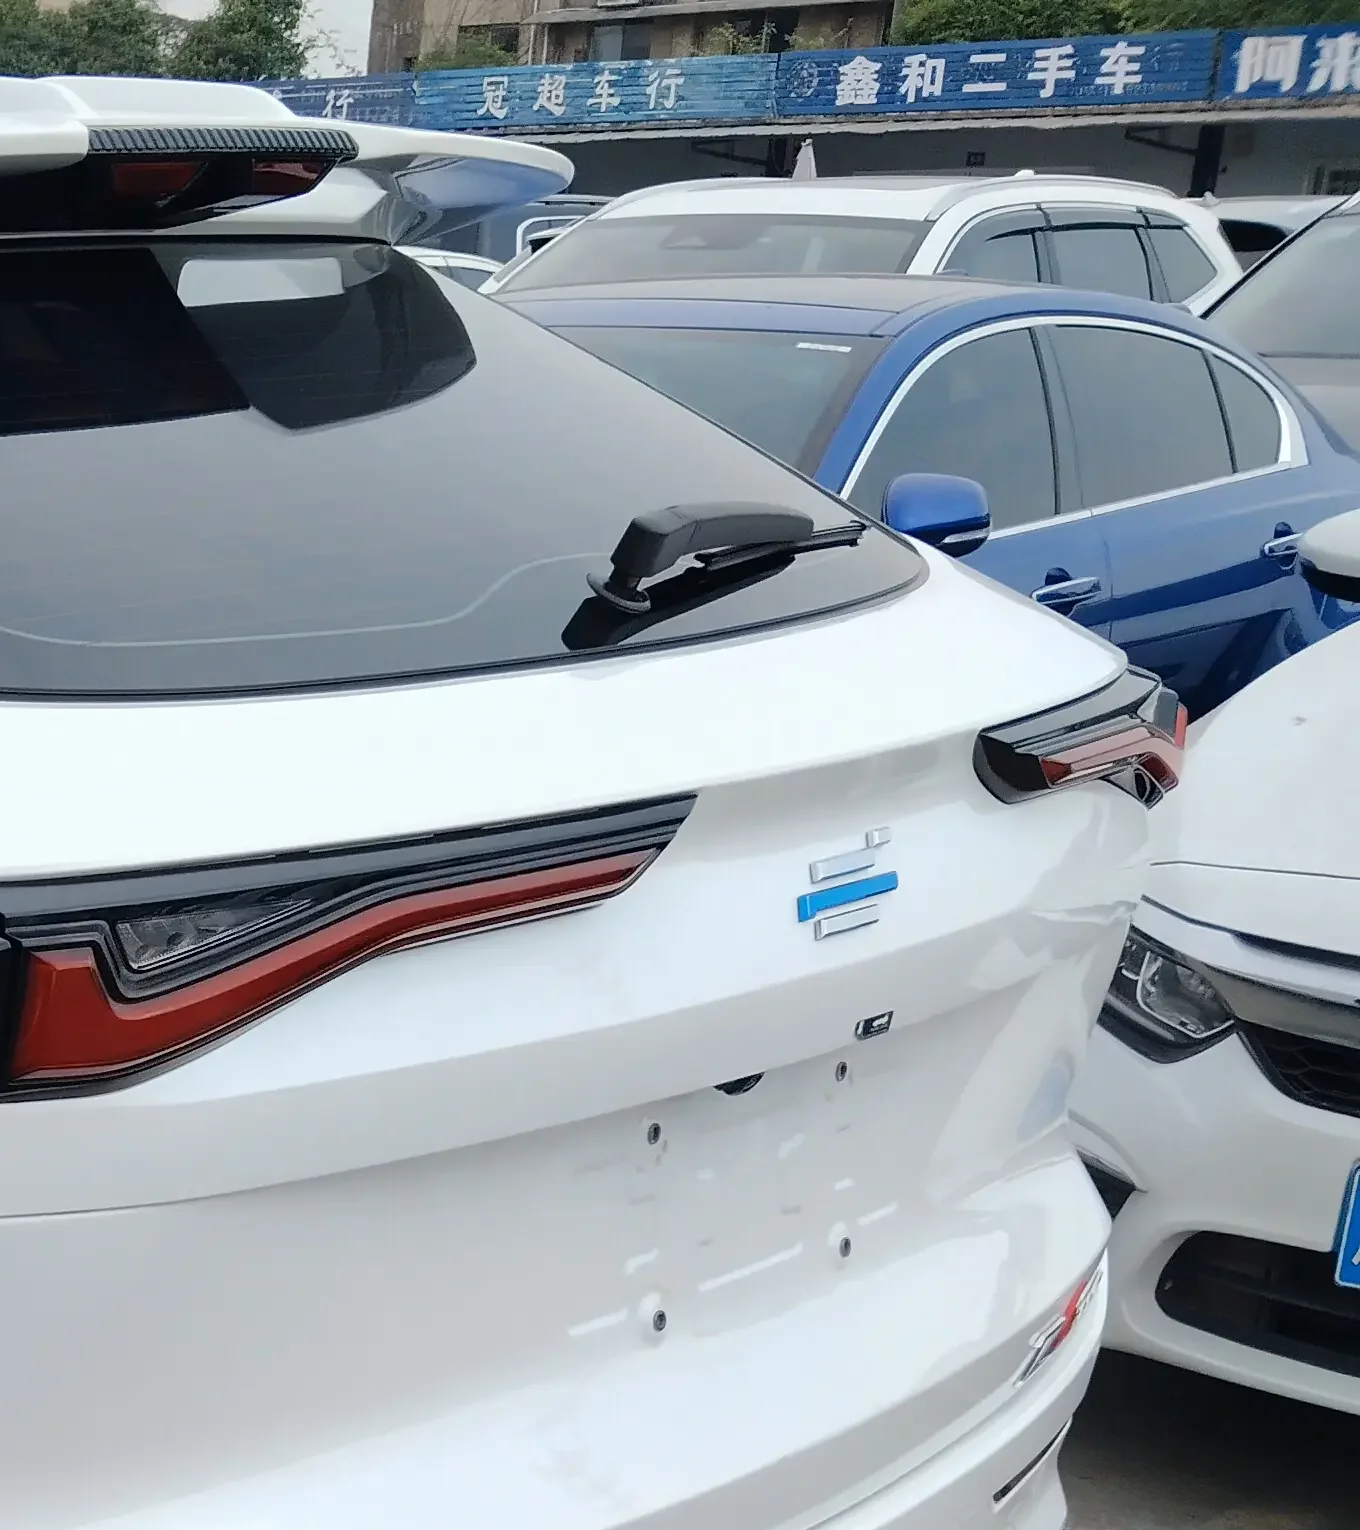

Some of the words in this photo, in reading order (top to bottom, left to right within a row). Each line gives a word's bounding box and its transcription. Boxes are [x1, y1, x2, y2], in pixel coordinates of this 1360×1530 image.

[477, 68, 685, 120] 冠超车行
[835, 41, 1146, 106] 鑫和二手车
